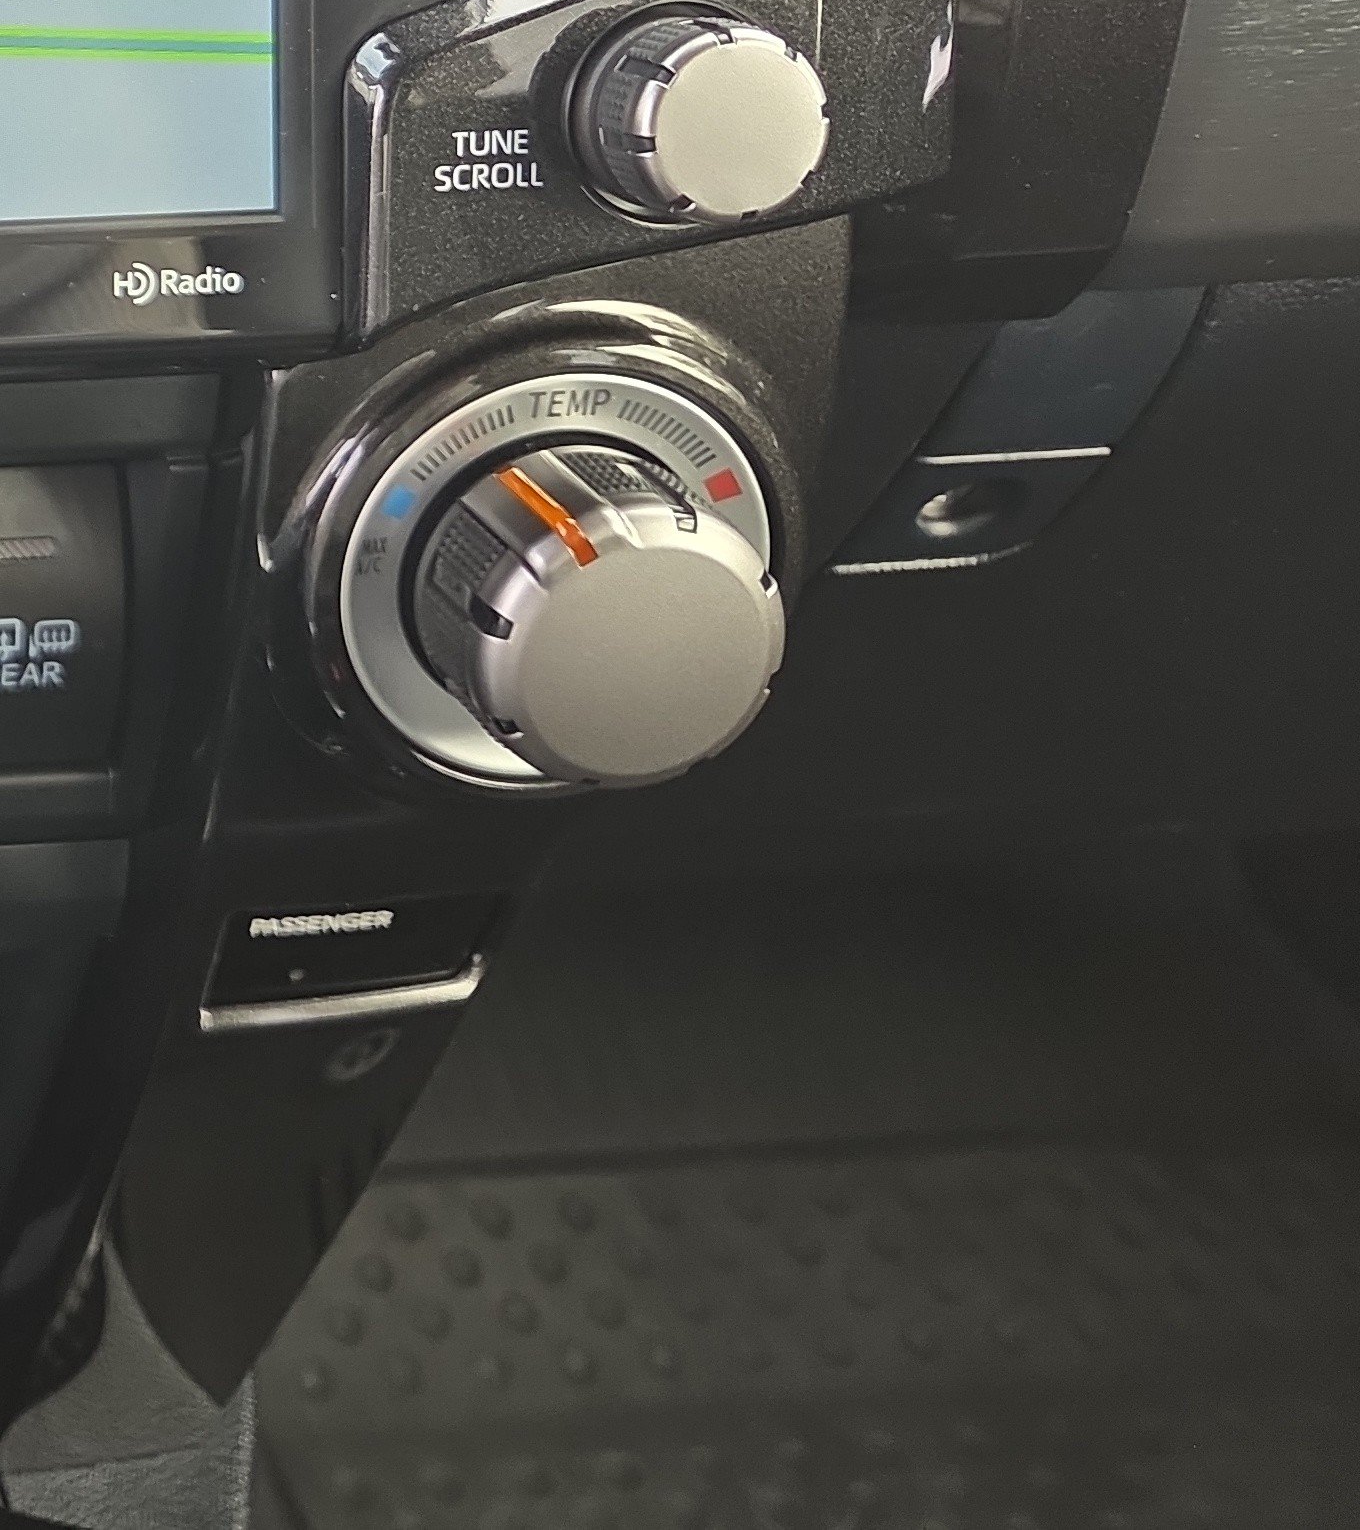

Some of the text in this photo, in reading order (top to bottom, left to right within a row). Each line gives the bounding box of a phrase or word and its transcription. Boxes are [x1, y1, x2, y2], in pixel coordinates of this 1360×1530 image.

[452, 128, 529, 157] TUNE
[433, 162, 544, 193] SCROLL
[160, 265, 244, 296] Radio
[528, 389, 613, 419] TEMP
[249, 909, 395, 939] PASSENGER
